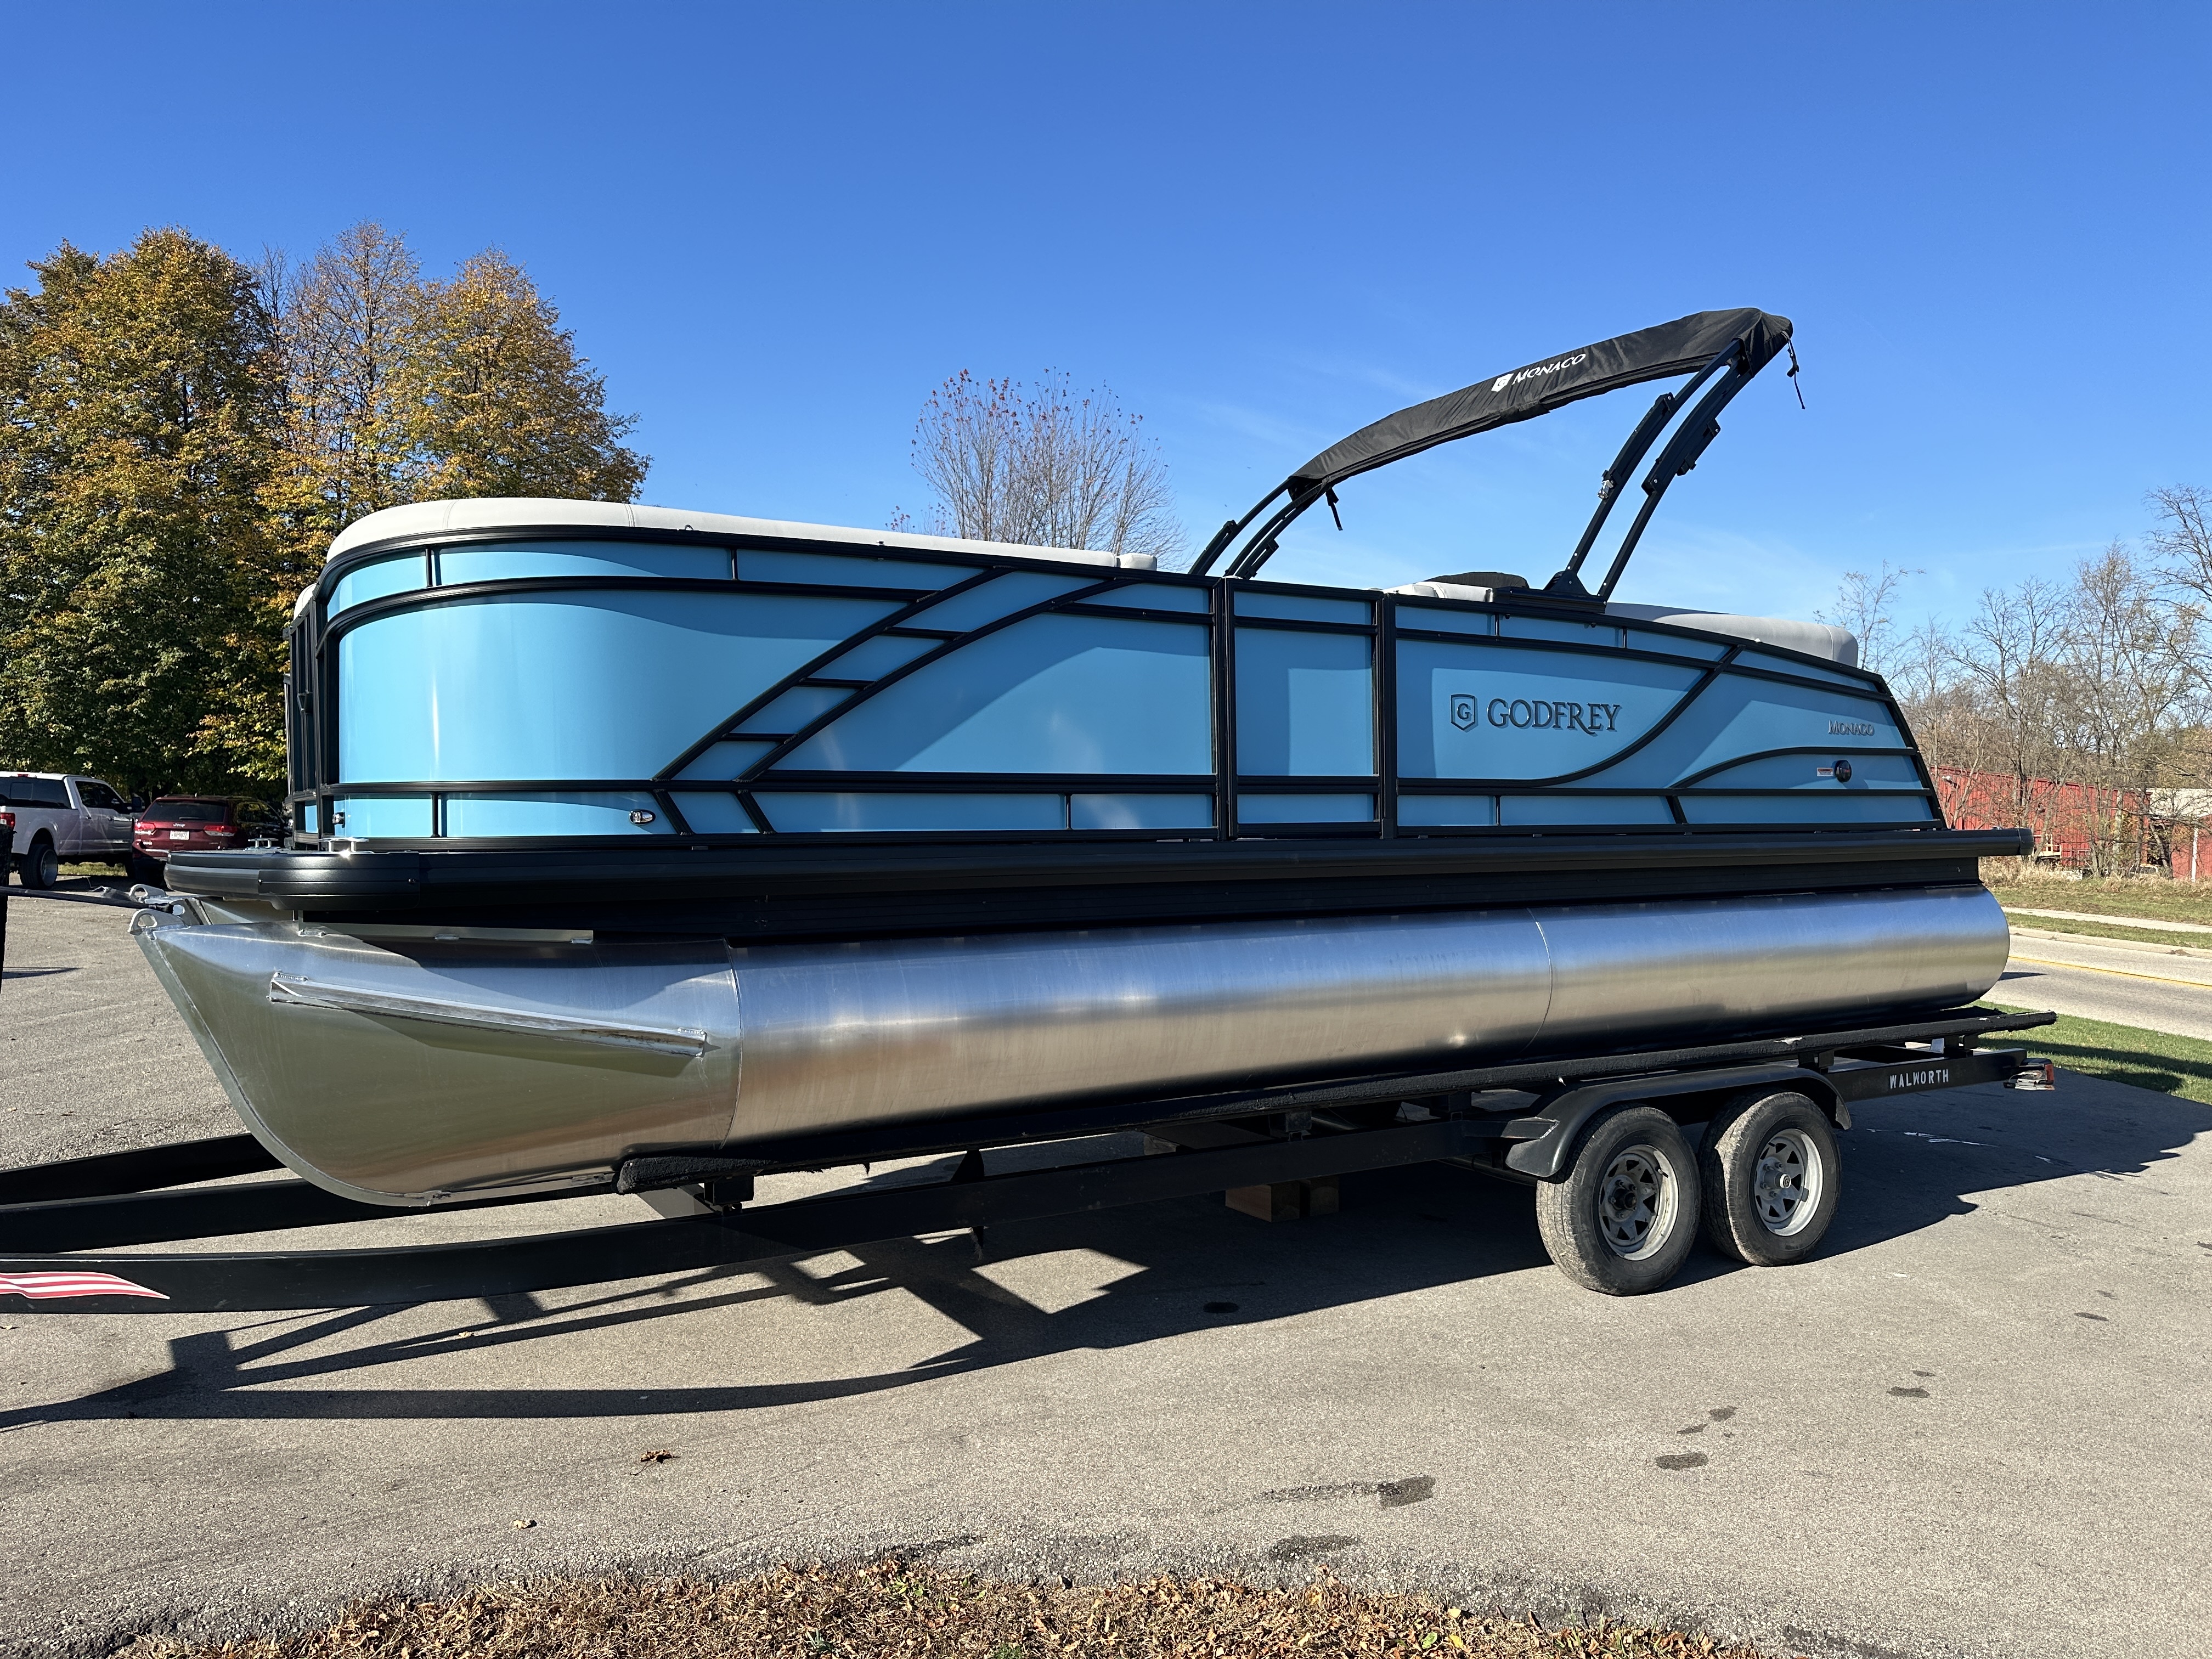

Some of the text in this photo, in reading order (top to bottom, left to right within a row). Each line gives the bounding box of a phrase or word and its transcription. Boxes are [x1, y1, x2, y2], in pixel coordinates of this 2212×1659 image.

[1511, 353, 1586, 385] MONACO
[1487, 698, 1620, 735] GODFREY
[1890, 1069, 1949, 1089] WALWORTH
